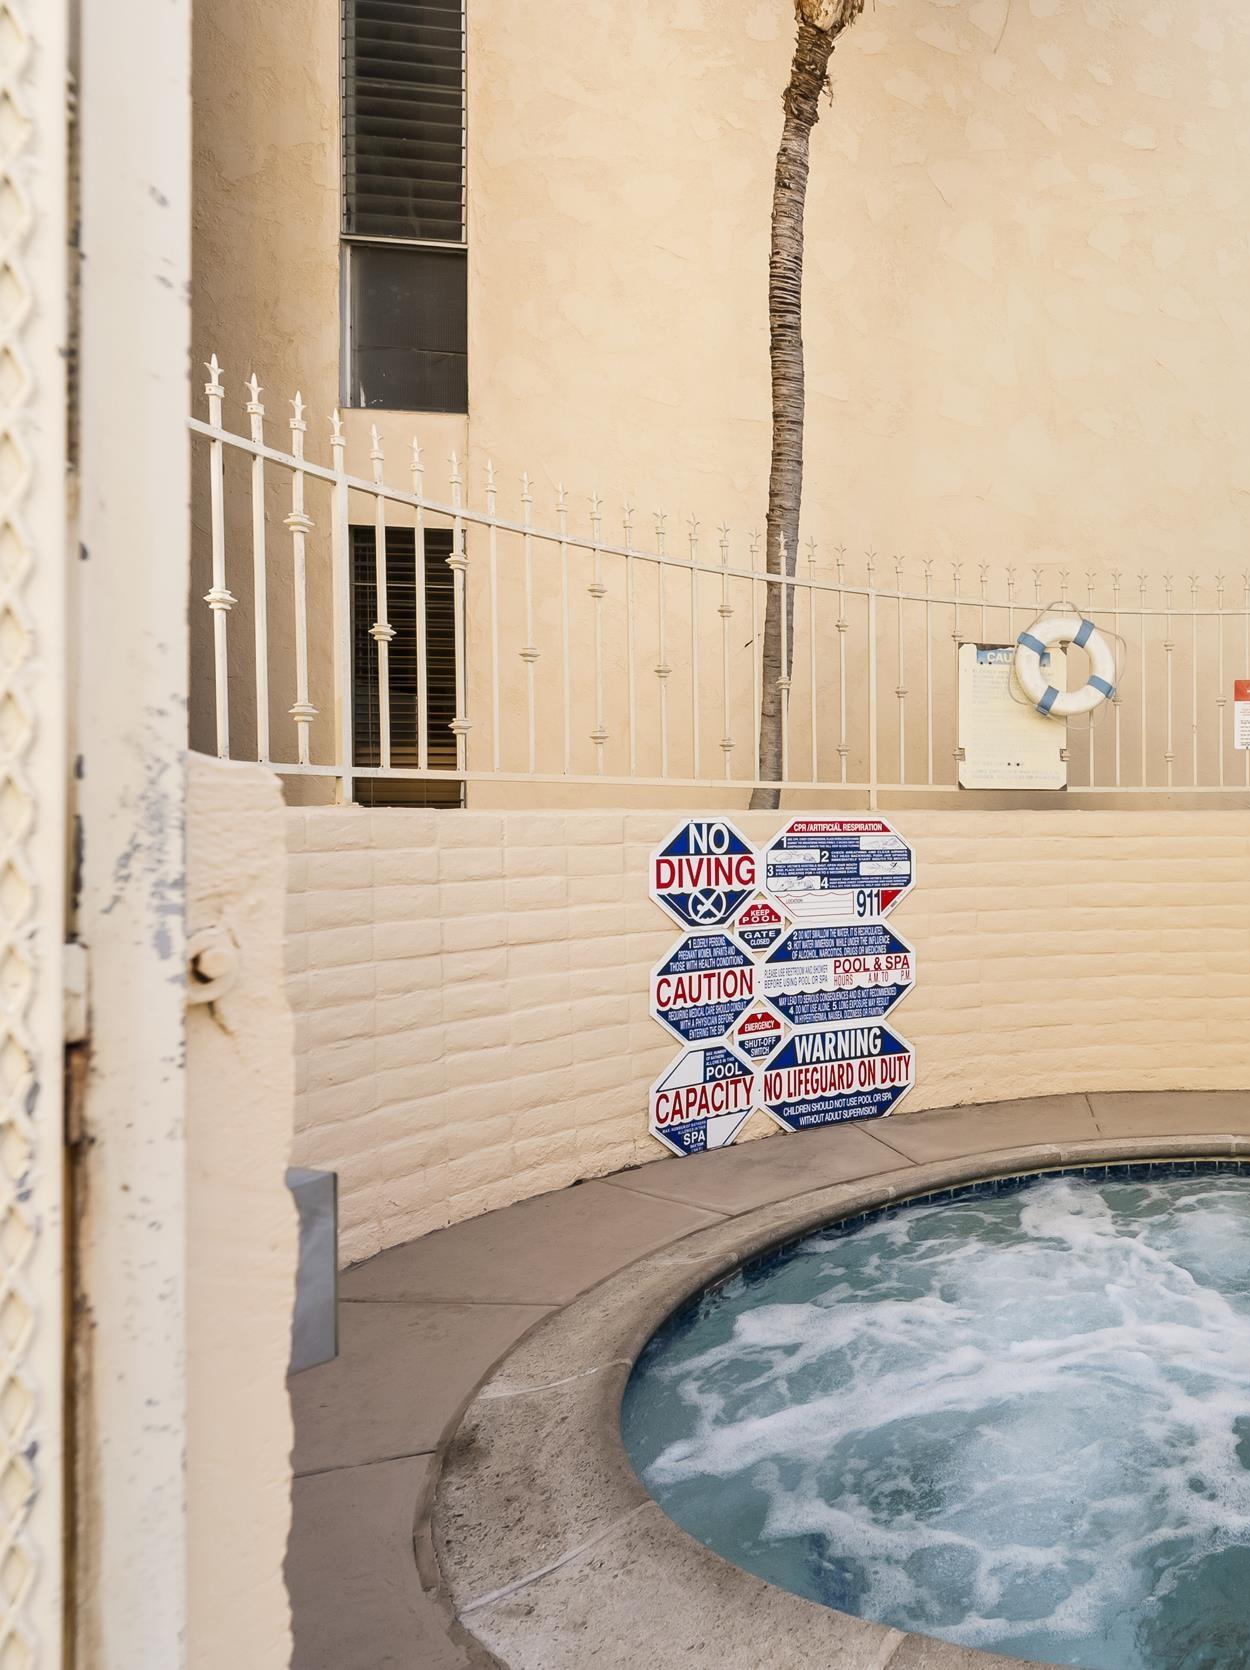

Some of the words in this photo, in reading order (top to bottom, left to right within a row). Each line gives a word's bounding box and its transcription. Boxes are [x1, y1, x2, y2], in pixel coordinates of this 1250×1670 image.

[843, 823, 882, 831] RESPIRATION
[689, 823, 730, 854] NO
[780, 837, 786, 848] 1
[821, 851, 829, 862] 2
[656, 855, 755, 889] DIVING
[768, 866, 773, 876] 3
[821, 877, 829, 888] 4
[857, 889, 880, 917] 911
[744, 931, 776, 939] GATE
[812, 929, 829, 939] SWALLOW
[850, 927, 853, 936] IT
[854, 927, 858, 935] IS
[693, 938, 708, 948] ELDERLY
[750, 938, 770, 946] CLOSED
[802, 940, 814, 949] WATER
[848, 937, 859, 946] UNDER
[860, 936, 868, 945] THE
[868, 935, 890, 944] INFLUENCE
[678, 949, 697, 960] PREGNANT
[792, 951, 798, 960] OF
[844, 947, 858, 956] DRUGS
[858, 946, 864, 954] OR
[865, 945, 886, 954] MEDICINES
[670, 962, 685, 972] THOSE
[686, 960, 697, 970] WITH
[698, 958, 715, 969] HEALTH
[717, 955, 743, 967] CONDITIONS
[834, 958, 870, 974] POOL
[874, 957, 882, 970] &
[886, 955, 910, 970] SPA
[765, 969, 777, 978] PLEASE
[786, 966, 804, 976] RESTROOM
[814, 965, 828, 974] SHOWER
[834, 975, 853, 986] HOURS
[882, 971, 888, 982] TO
[657, 968, 753, 1007] CAUTION
[765, 978, 782, 989] BEFORE
[783, 977, 797, 986] USING
[799, 976, 810, 985] POOL
[812, 975, 818, 984] OR
[820, 974, 828, 983] SPA
[787, 996, 796, 1005] LEAD
[797, 995, 802, 1004] TO
[803, 994, 819, 1003] SERIOUS
[820, 991, 848, 1002] CONSEQUENCES
[857, 990, 861, 998] IS
[870, 987, 896, 997] RECOMMENDED
[668, 1010, 688, 1021] REQUIRING
[689, 1008, 705, 1018] MEDICAL
[705, 1006, 715, 1016] CARE
[716, 1004, 730, 1014] SHOULD
[796, 1006, 800, 1014] DO
[801, 1005, 809, 1014] NOT
[839, 1001, 848, 1010] LONG
[849, 999, 867, 1009] EXPOSURE
[868, 998, 876, 1007] MAY
[680, 1019, 691, 1030] WITH
[692, 1019, 694, 1027] A
[696, 1015, 717, 1027] PHYSICIAN
[718, 1013, 734, 1024] BEFORE
[745, 1020, 774, 1032] EMERGENCY
[689, 1028, 709, 1039] ENTERING
[709, 1026, 717, 1036] THE
[745, 1037, 776, 1048] SHUT-OFF
[794, 1027, 882, 1064] WARNING
[751, 1047, 769, 1056] SWITCH
[707, 1062, 742, 1080] POOL
[764, 1072, 782, 1102] NO
[787, 1062, 854, 1098] LIFEGUARD
[858, 1059, 875, 1087] ON
[880, 1055, 911, 1084] DUTY
[656, 1076, 754, 1124] CAPACITY
[783, 1104, 811, 1116] CHILDREN
[812, 1101, 834, 1112] SHOULD
[834, 1099, 846, 1108] NOT
[846, 1097, 857, 1107] USE
[858, 1096, 872, 1105] POOL
[873, 1094, 881, 1103] OR
[882, 1092, 892, 1101] SPA
[800, 1114, 824, 1126] WITHOUT
[825, 1111, 842, 1123] ADULT
[842, 1106, 877, 1119] SUPERVISION
[684, 1130, 705, 1145] SPA
